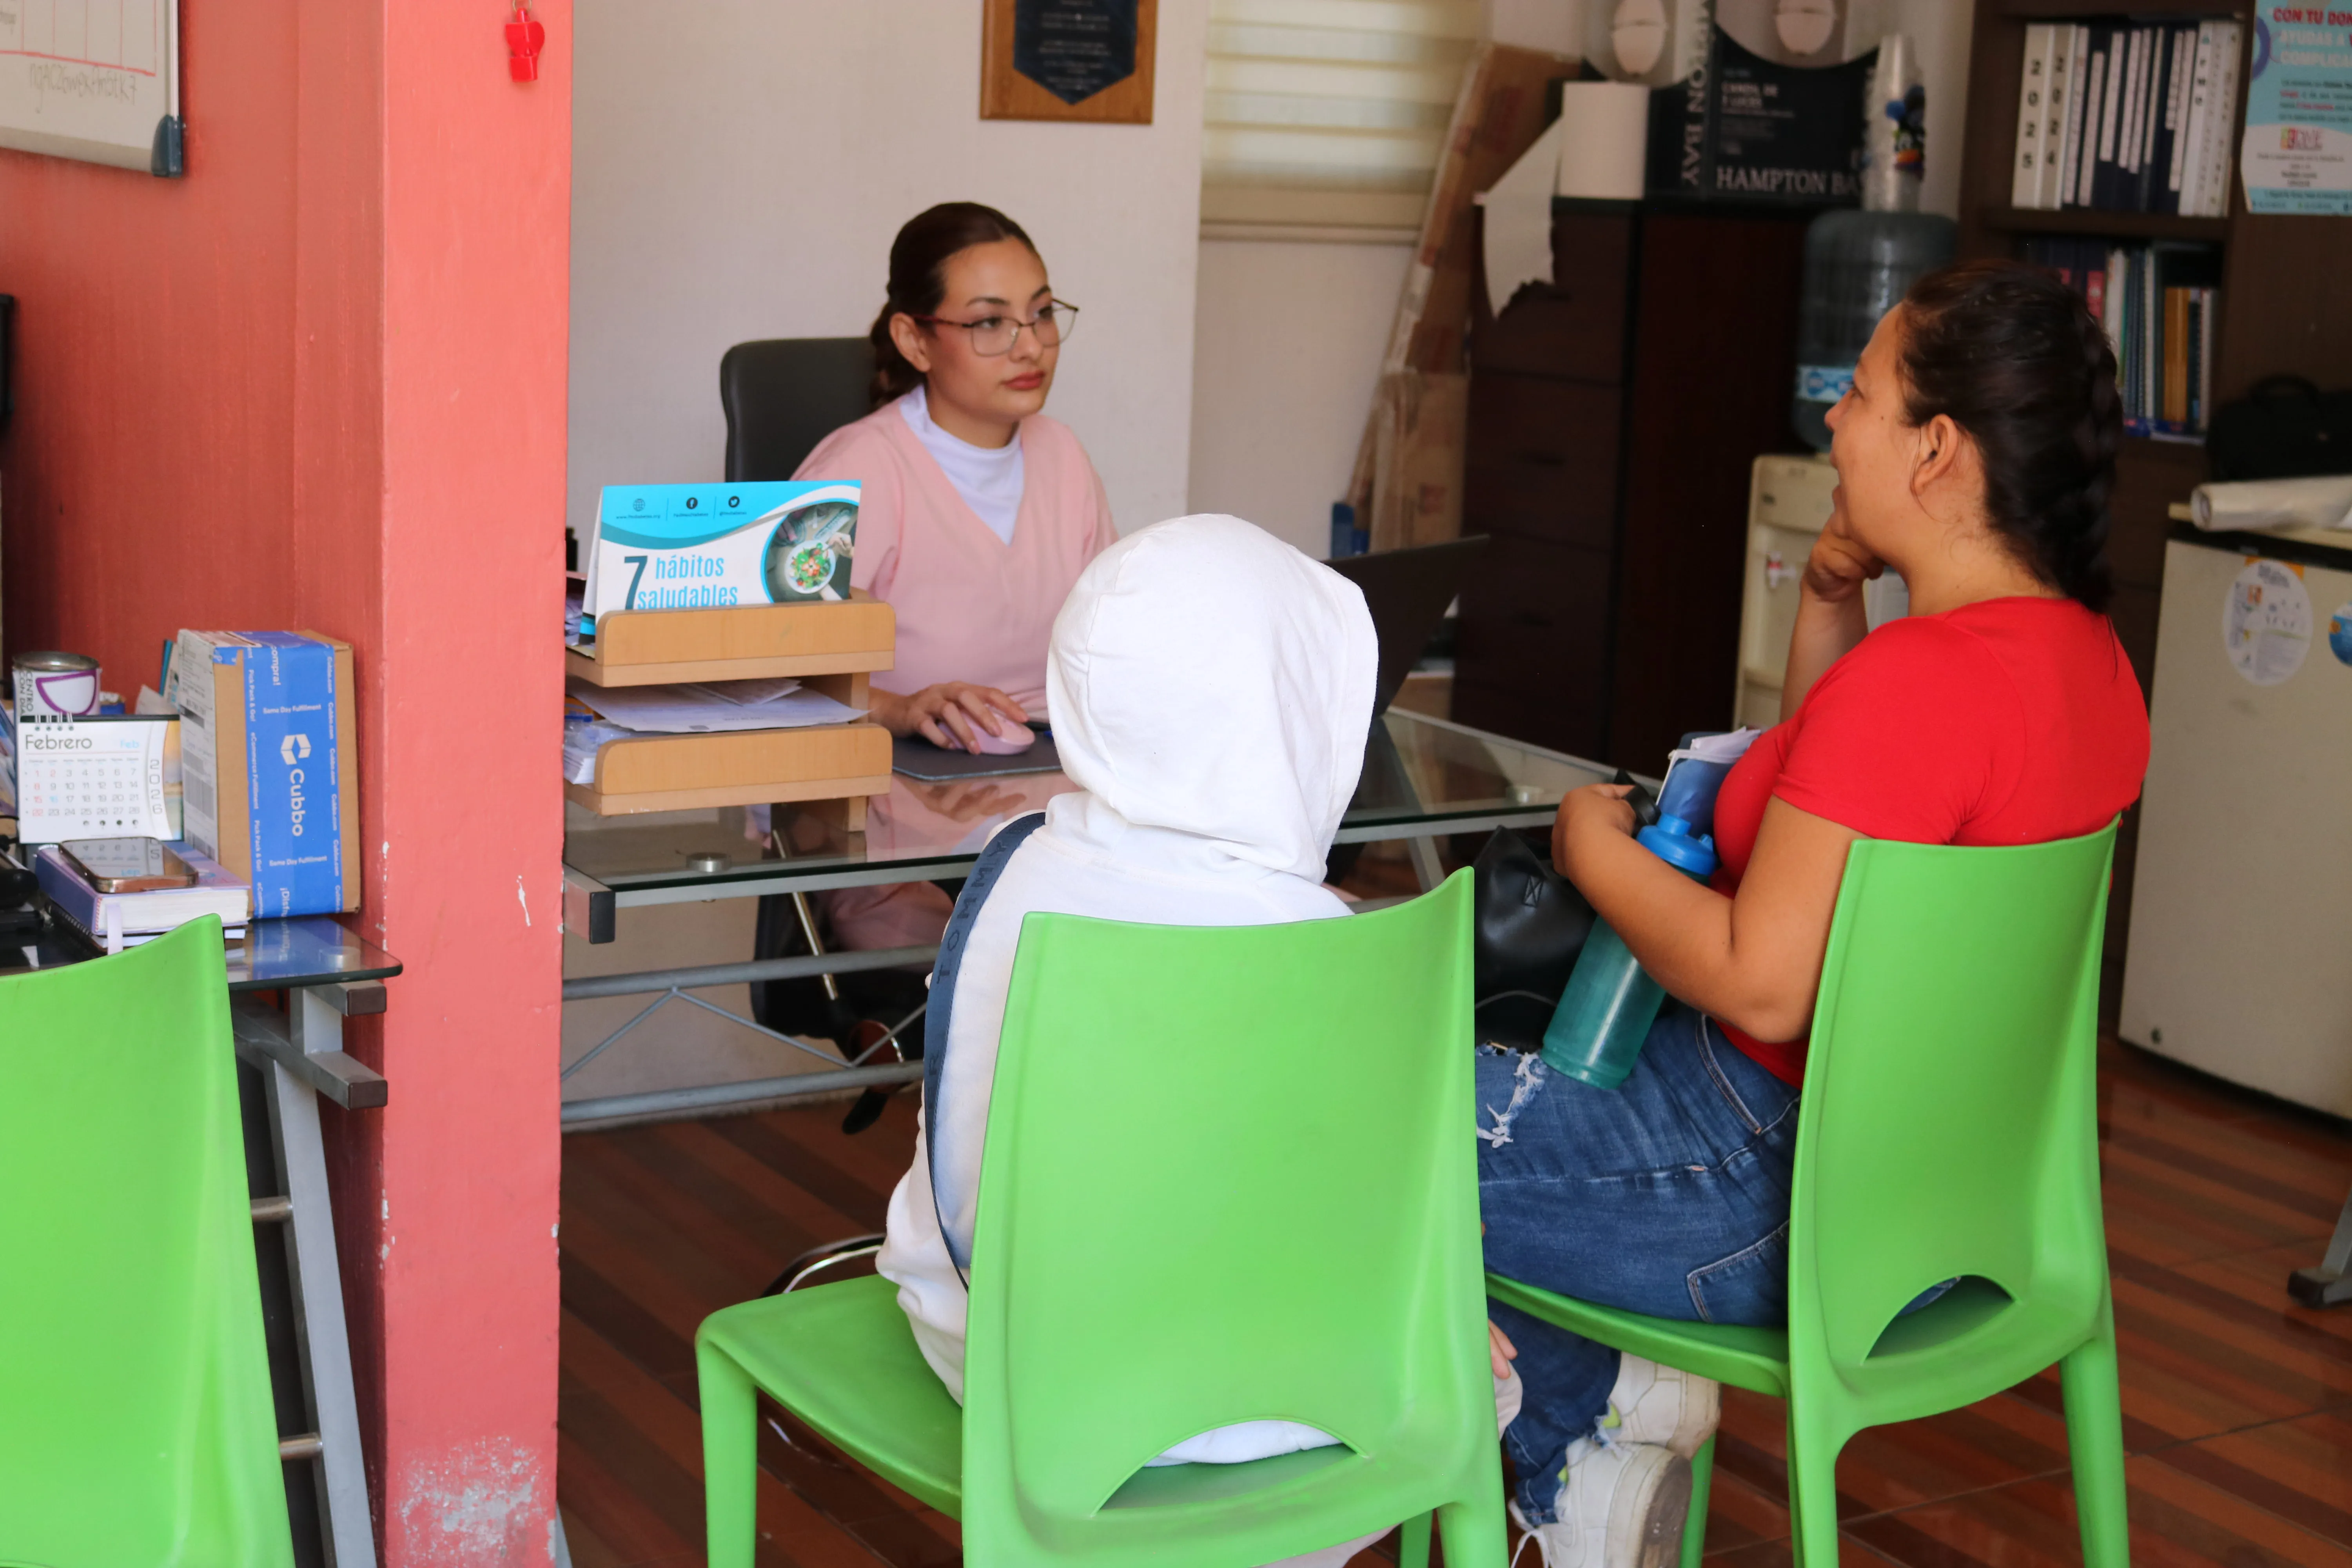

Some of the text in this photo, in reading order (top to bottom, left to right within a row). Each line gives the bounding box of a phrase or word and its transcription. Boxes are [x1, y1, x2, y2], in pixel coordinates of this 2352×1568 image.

[2273, 6, 2303, 24] CON
[2306, 8, 2324, 25] TU
[1716, 165, 1826, 194] HAMPTON
[624, 555, 724, 610] 7 hábitos
[637, 584, 738, 610] saludables
[25, 735, 140, 750] Febrero Feb
[290, 768, 305, 837] Cubbo
[936, 840, 1009, 984] TOMMY
